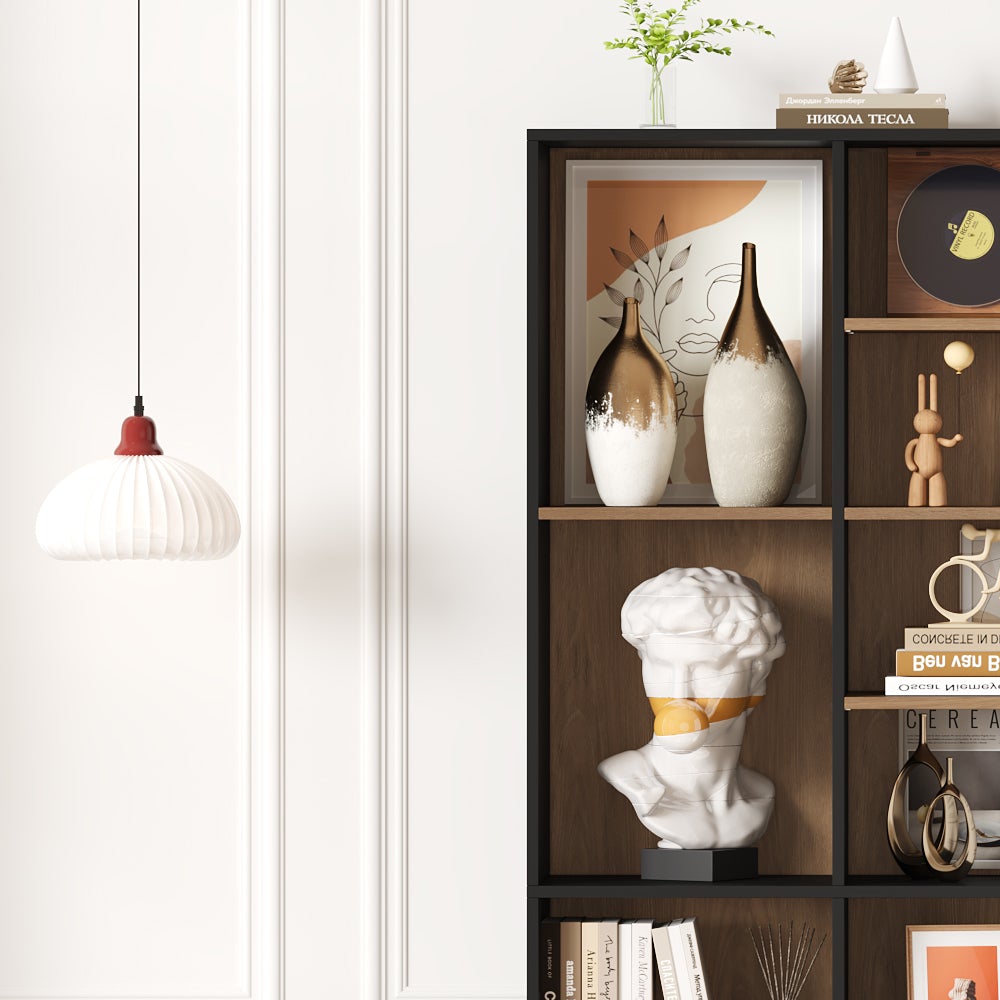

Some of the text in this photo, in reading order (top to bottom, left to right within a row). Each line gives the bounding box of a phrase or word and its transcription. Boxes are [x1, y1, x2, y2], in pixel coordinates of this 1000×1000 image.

[806, 114, 915, 125] НИКОЛА ТЕСЛА
[960, 211, 975, 236] RECORD
[638, 936, 647, 960] Karen
[566, 960, 576, 997] amanda
[587, 950, 596, 988] Arianna
